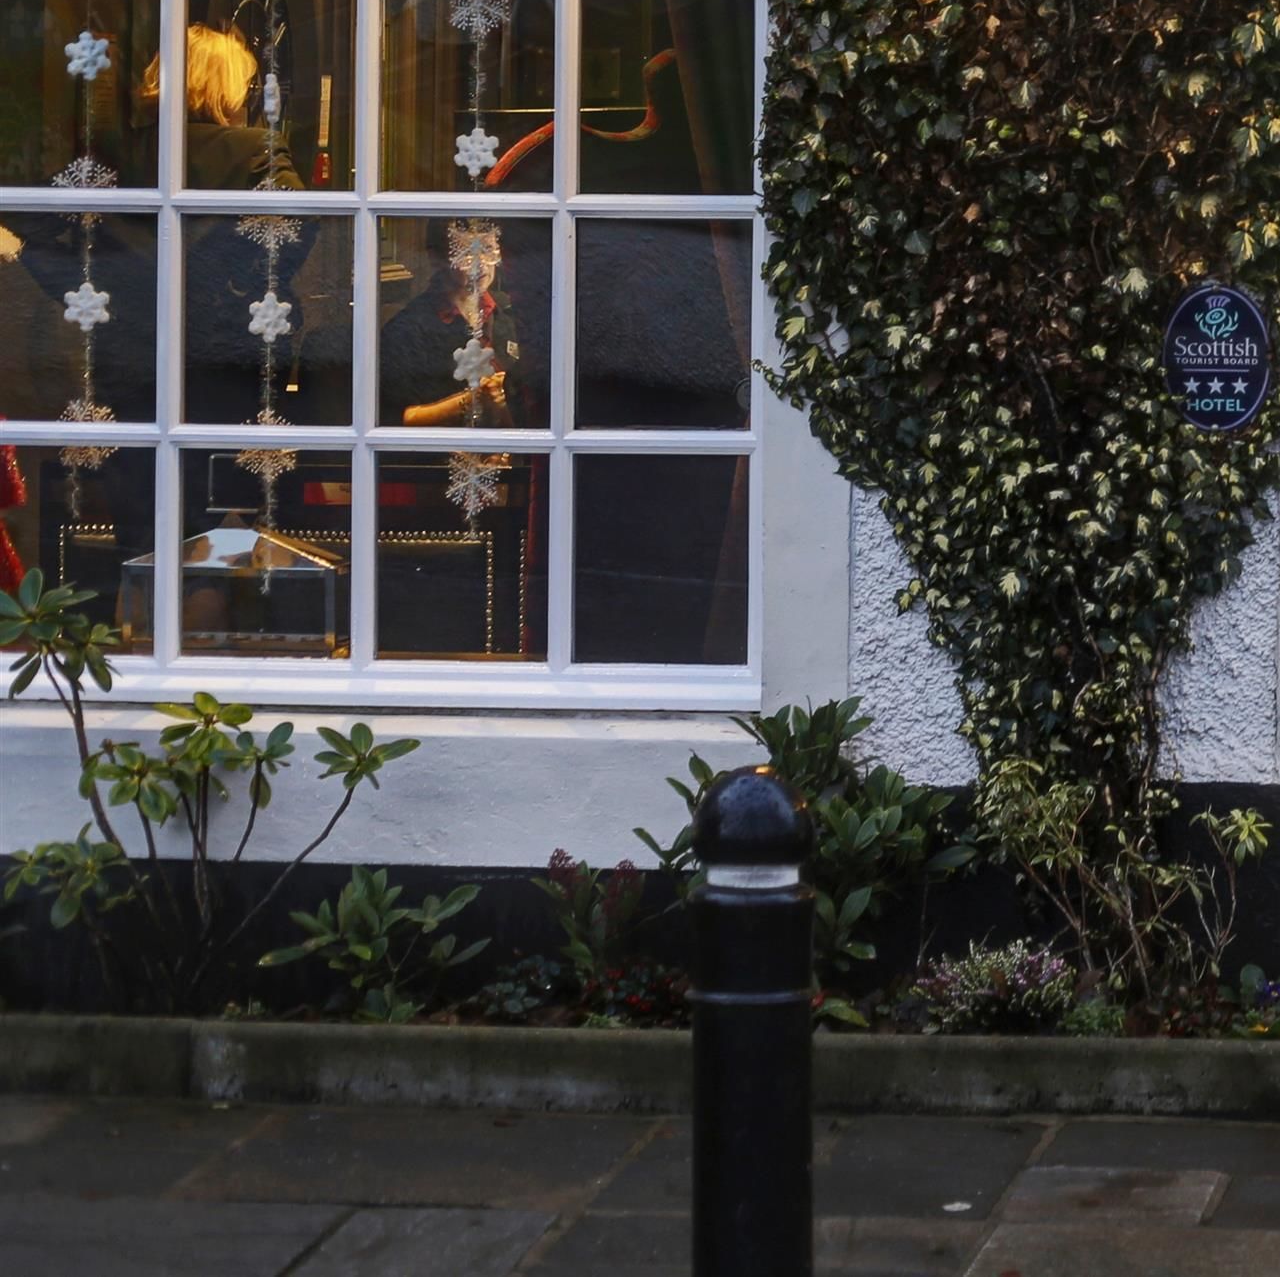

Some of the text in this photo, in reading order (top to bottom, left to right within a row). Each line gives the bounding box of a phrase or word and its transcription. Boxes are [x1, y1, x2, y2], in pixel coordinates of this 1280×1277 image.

[1173, 335, 1259, 357] Scottish
[1175, 357, 1259, 366] TOURIST BOARD
[1186, 398, 1246, 412] HOTEL
